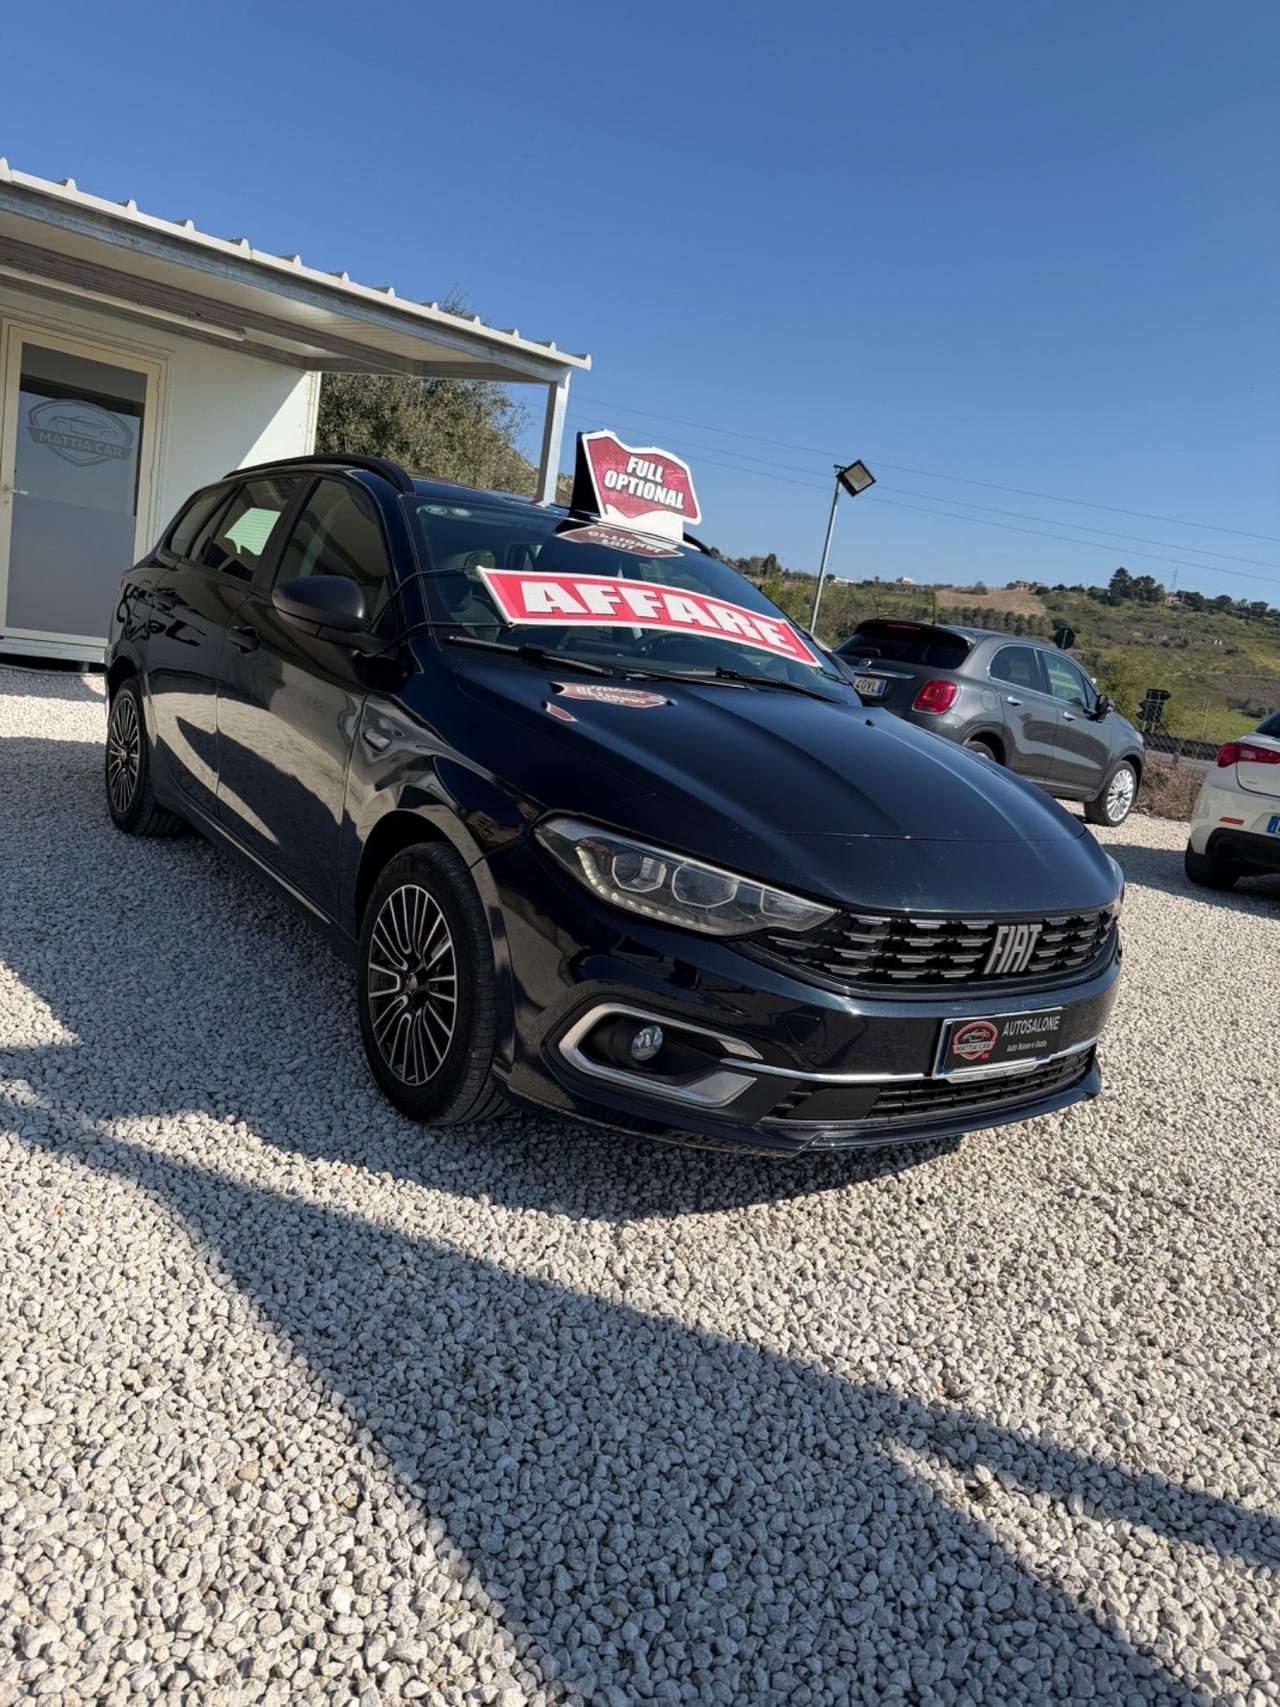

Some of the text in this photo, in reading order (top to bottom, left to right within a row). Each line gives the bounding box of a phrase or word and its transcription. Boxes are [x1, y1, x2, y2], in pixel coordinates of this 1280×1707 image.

[39, 431, 122, 458] MATTIA CAR
[626, 456, 664, 483] FULL
[604, 470, 684, 509] OPTIONAL
[520, 581, 798, 653] AFFARE
[983, 924, 1043, 974] FIAT
[1002, 1016, 1061, 1037] AUTOSALONE
